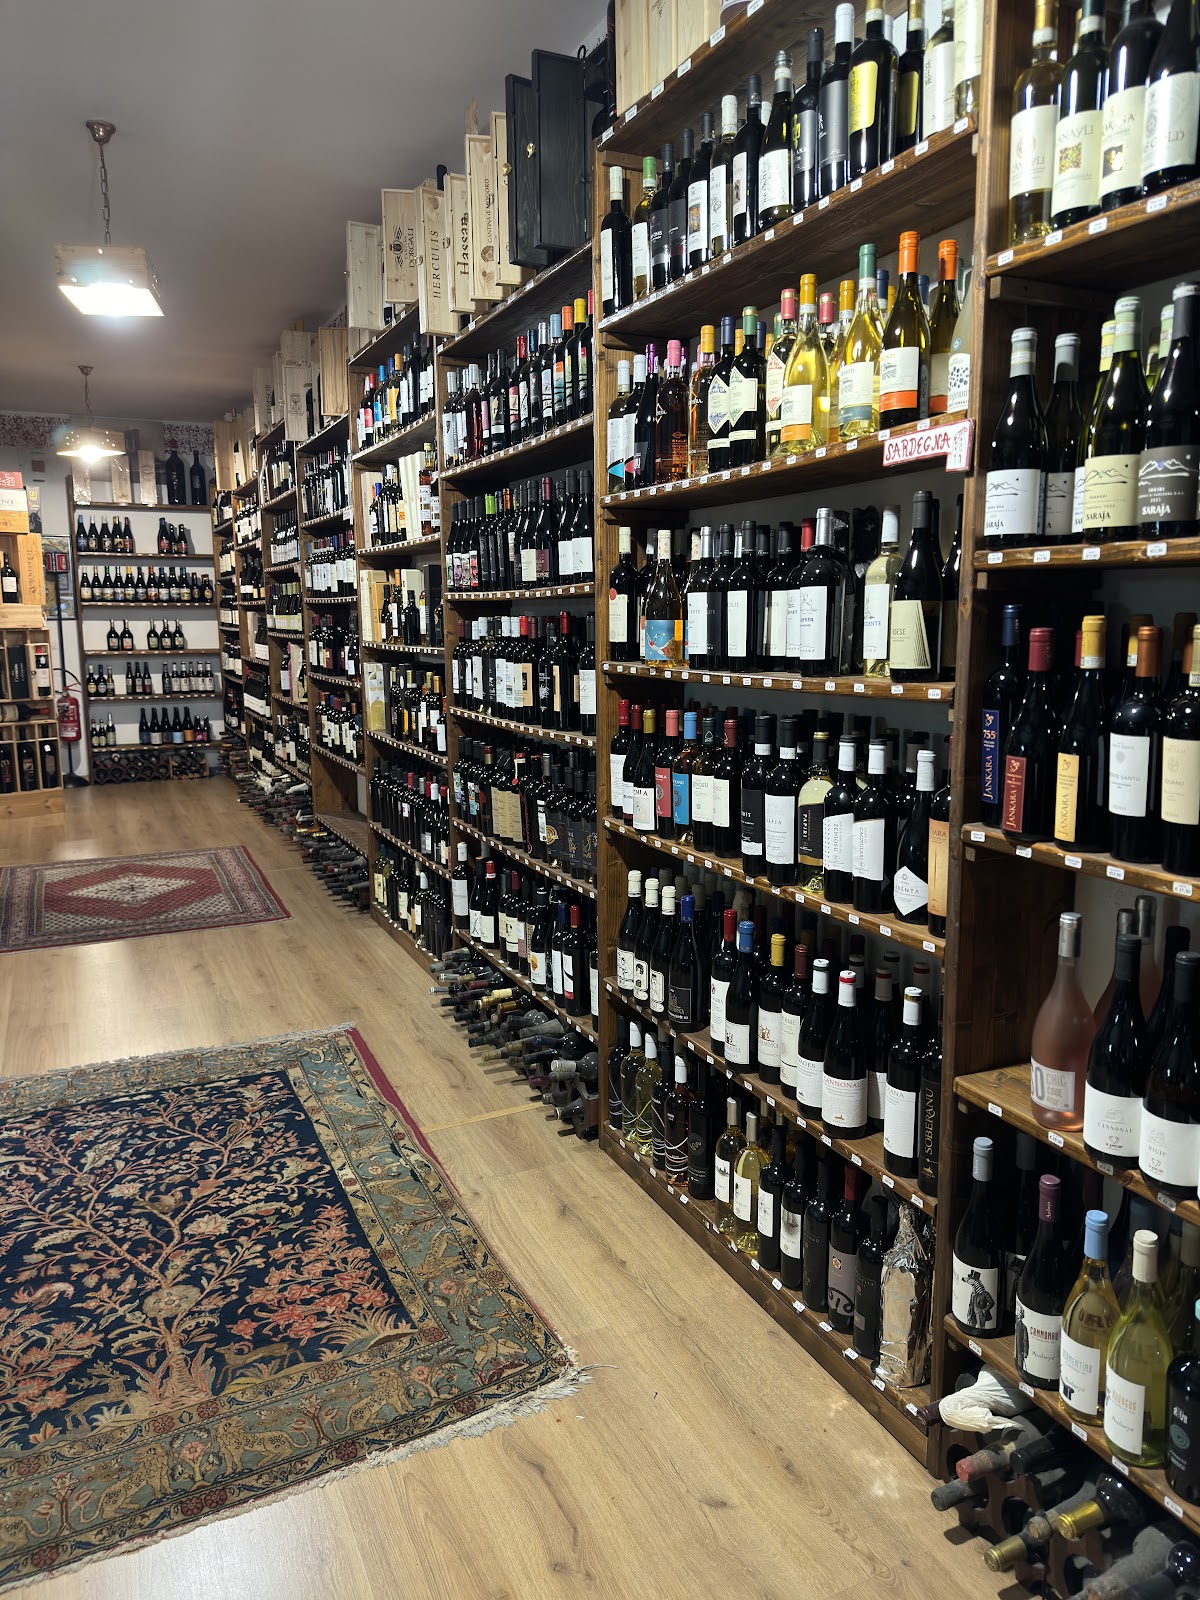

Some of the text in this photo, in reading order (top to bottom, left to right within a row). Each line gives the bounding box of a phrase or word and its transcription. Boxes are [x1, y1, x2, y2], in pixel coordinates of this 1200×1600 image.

[432, 229, 442, 300] HERCULIS
[885, 432, 951, 462] SARDEGNA
[983, 755, 993, 800] JANKARA
[1006, 789, 1018, 828] JANKARA
[1058, 793, 1069, 836] JANKARA
[1046, 1073, 1066, 1087] CHIC
[924, 1088, 935, 1155] SOBERANU
[1097, 1122, 1134, 1134] CANNONAU
[1029, 1326, 1059, 1341] CANNONAU
[1111, 1415, 1135, 1433] Audarya
